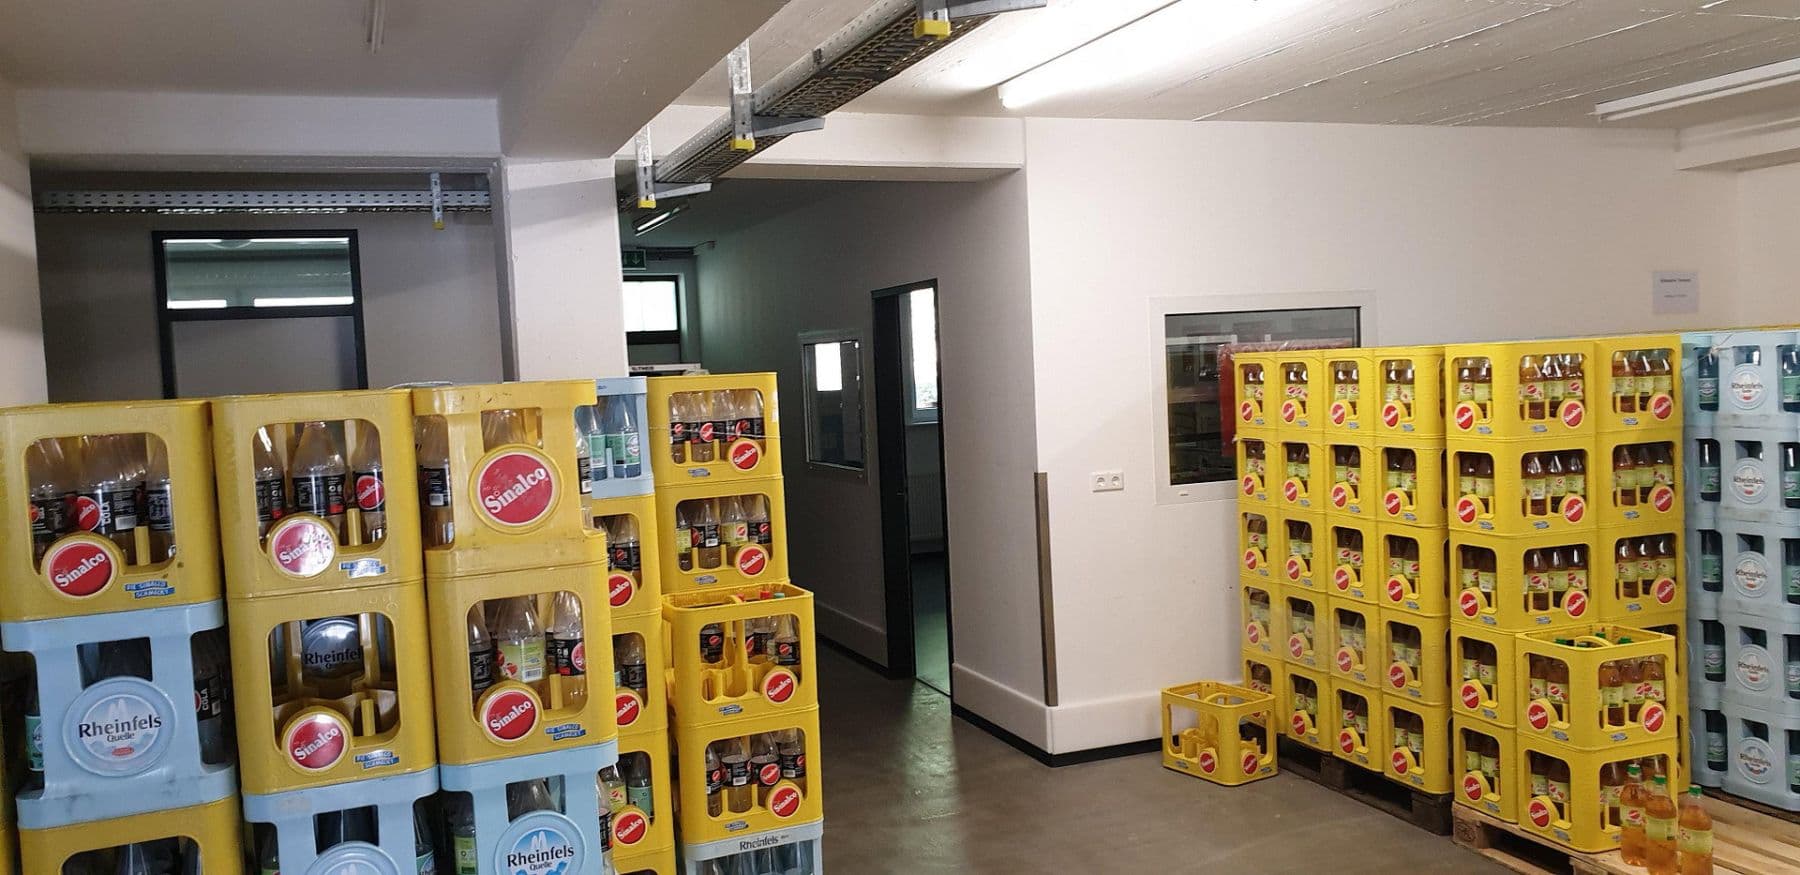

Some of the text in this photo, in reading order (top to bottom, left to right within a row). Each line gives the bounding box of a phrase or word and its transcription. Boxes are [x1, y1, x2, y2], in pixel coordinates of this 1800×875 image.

[485, 468, 547, 514] Sinalco
[55, 552, 105, 587] Sinalco
[304, 649, 362, 665] Rheinfel
[79, 714, 162, 738] Rheinfels
[490, 700, 532, 731] Sinalco
[107, 731, 135, 743] Quelle
[294, 727, 340, 760] Sinalco
[740, 835, 779, 851] Rheinfels
[507, 845, 575, 867] Rheinfels
